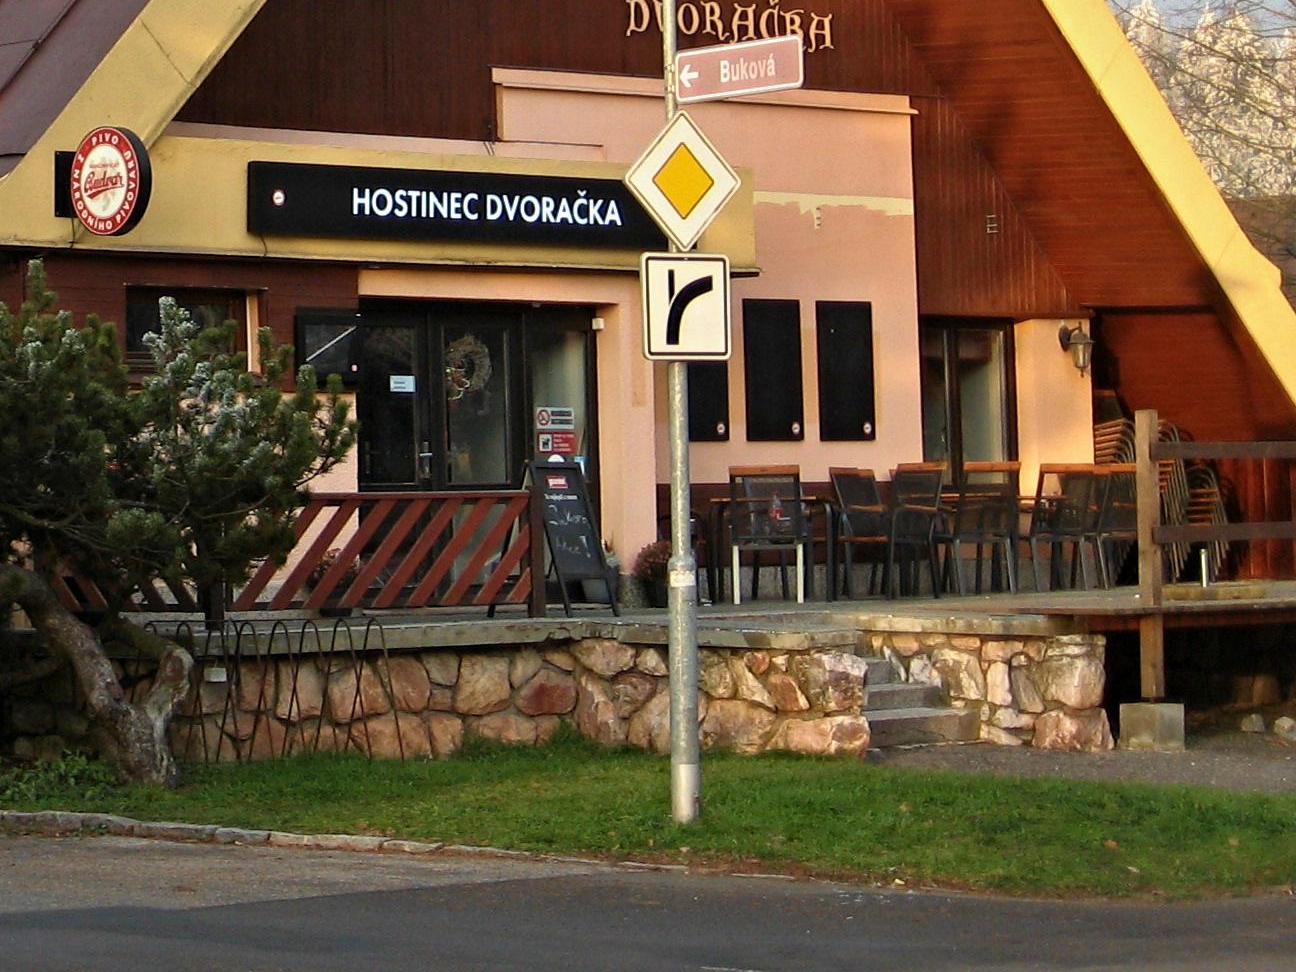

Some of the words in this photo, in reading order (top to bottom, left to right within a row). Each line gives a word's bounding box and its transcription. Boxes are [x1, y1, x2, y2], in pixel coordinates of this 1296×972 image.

[719, 53, 775, 83] Buková
[91, 132, 119, 146] PIVO
[75, 153, 85, 163] Z
[115, 150, 136, 223] PIVOVARU
[352, 187, 479, 221] HOSTINEC
[485, 189, 622, 226] DVORAČKA
